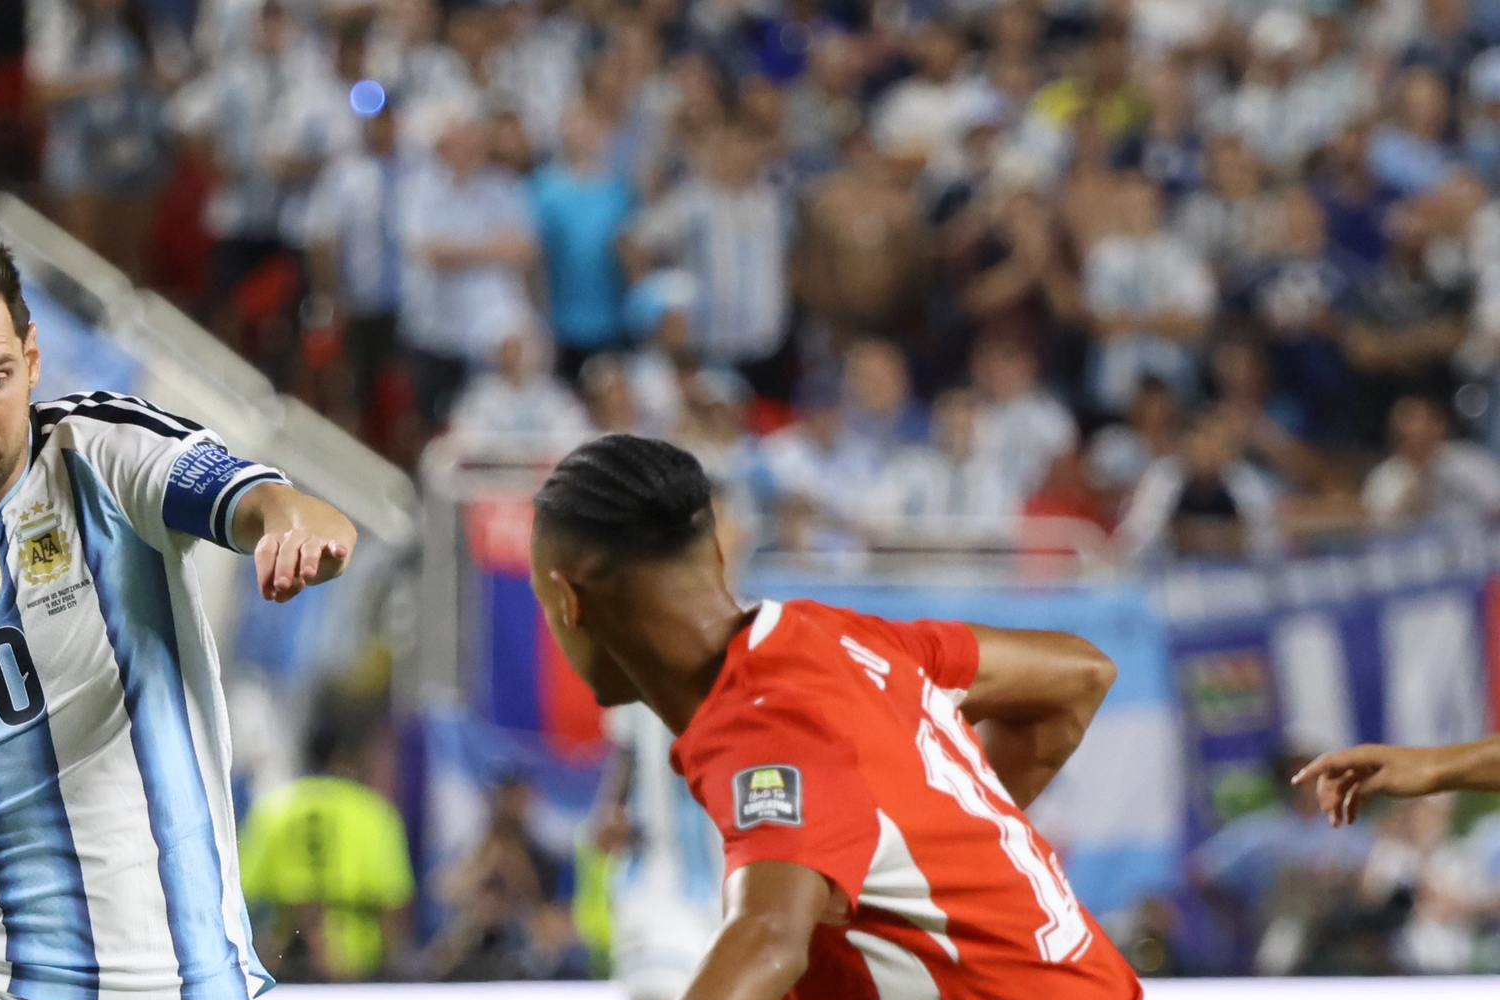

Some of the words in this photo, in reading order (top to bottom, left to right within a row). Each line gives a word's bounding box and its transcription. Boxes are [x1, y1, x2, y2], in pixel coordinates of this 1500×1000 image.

[168, 443, 218, 484] FOOTBALL
[177, 448, 231, 489] UNITES
[193, 476, 215, 495] the
